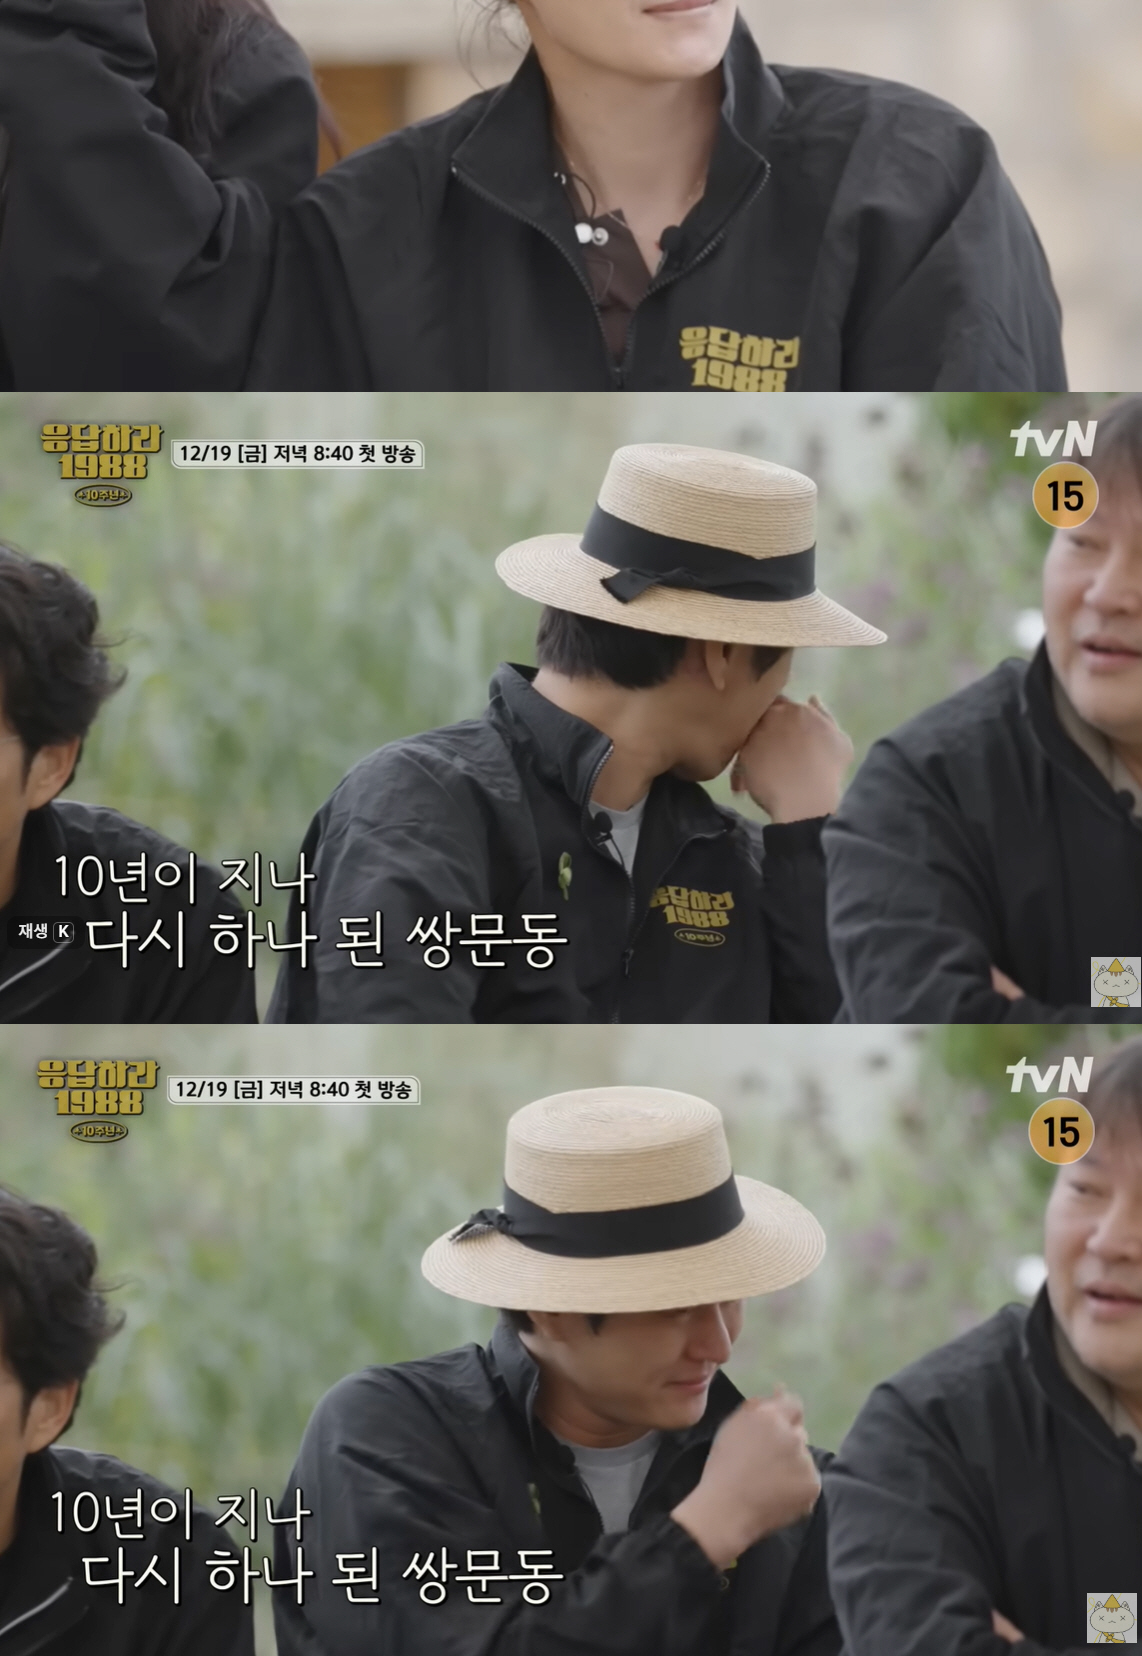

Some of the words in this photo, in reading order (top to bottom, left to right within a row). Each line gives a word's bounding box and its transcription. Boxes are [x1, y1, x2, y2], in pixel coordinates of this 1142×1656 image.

[679, 325, 800, 369] 응답하라
[691, 357, 787, 392] 1988
[663, 905, 730, 928] 1988
